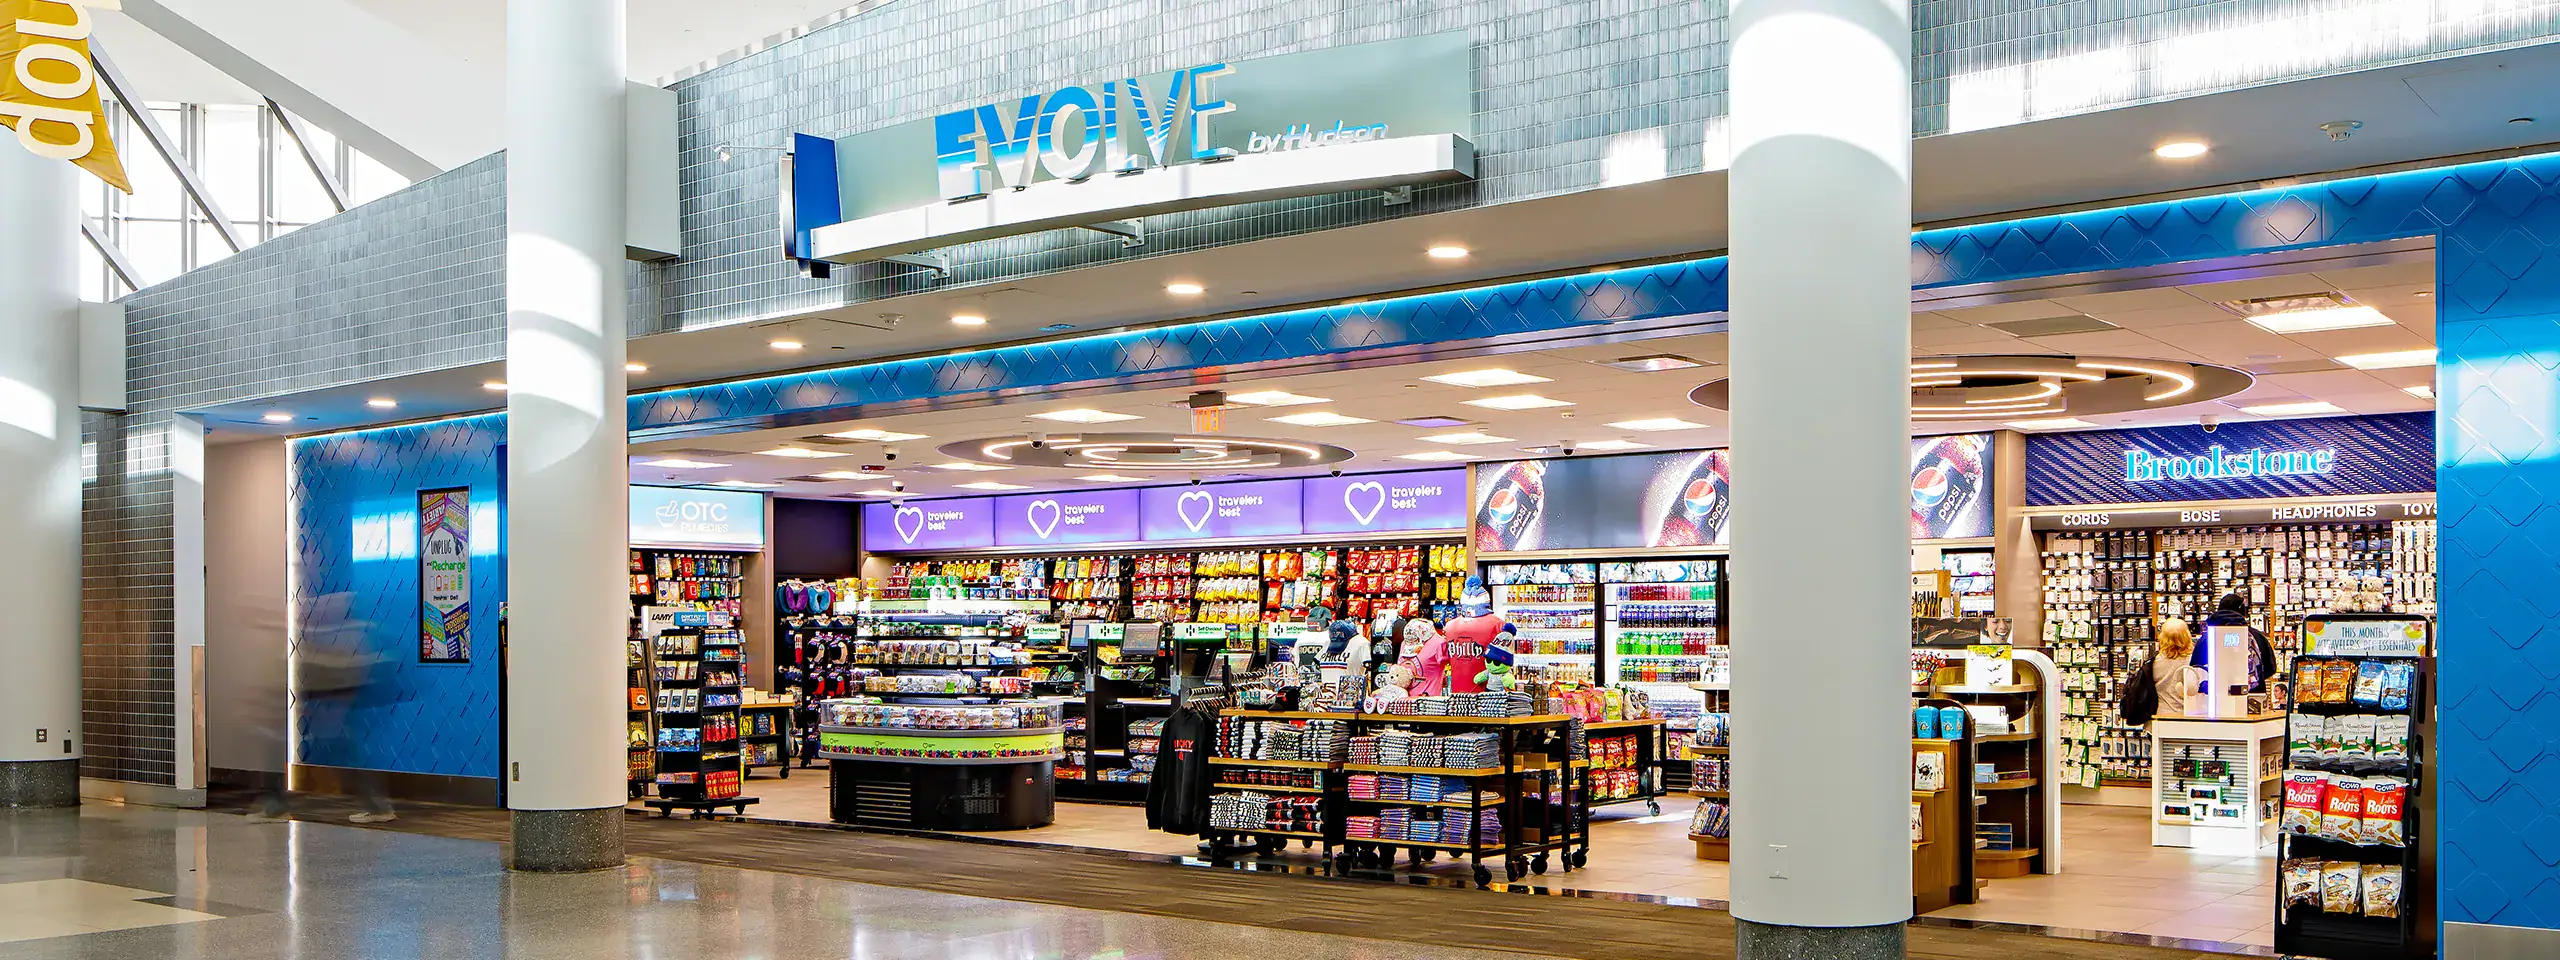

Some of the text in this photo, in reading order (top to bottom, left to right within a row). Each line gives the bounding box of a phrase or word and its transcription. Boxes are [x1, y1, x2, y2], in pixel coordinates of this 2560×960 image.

[934, 62, 1389, 199] EVOLVE by Hudson
[2124, 446, 2332, 482] Brookstone
[1391, 485, 1443, 499] travelers
[1218, 494, 1264, 507] travelers
[1391, 496, 1417, 510] best
[1938, 484, 1962, 521] pepsi
[681, 500, 728, 522] OTC
[927, 510, 964, 522] travelers
[1064, 503, 1105, 516] travelers
[1218, 506, 1241, 518] best
[1708, 494, 1728, 529] pepsi
[2272, 504, 2377, 521] HEADPHONES
[1064, 513, 1085, 526] best
[1509, 503, 1528, 536] pepsi
[2061, 513, 2110, 526] CORDS
[2180, 510, 2221, 523] BOSE
[927, 520, 946, 531] best
[431, 539, 452, 555] UNPLUG
[431, 560, 466, 573] Recharge
[651, 613, 673, 621] LAMY
[2341, 627, 2356, 638] THIS
[1448, 639, 1483, 660] Philly
[1320, 652, 1350, 662] PHILLY
[2295, 775, 2316, 783] GOYA
[2340, 782, 2361, 790] GOYA
[2375, 784, 2395, 792] GOYA
[2287, 789, 2317, 804] ROOTS
[2329, 797, 2360, 813] ROOTS
[2366, 799, 2398, 814] ROOTS
